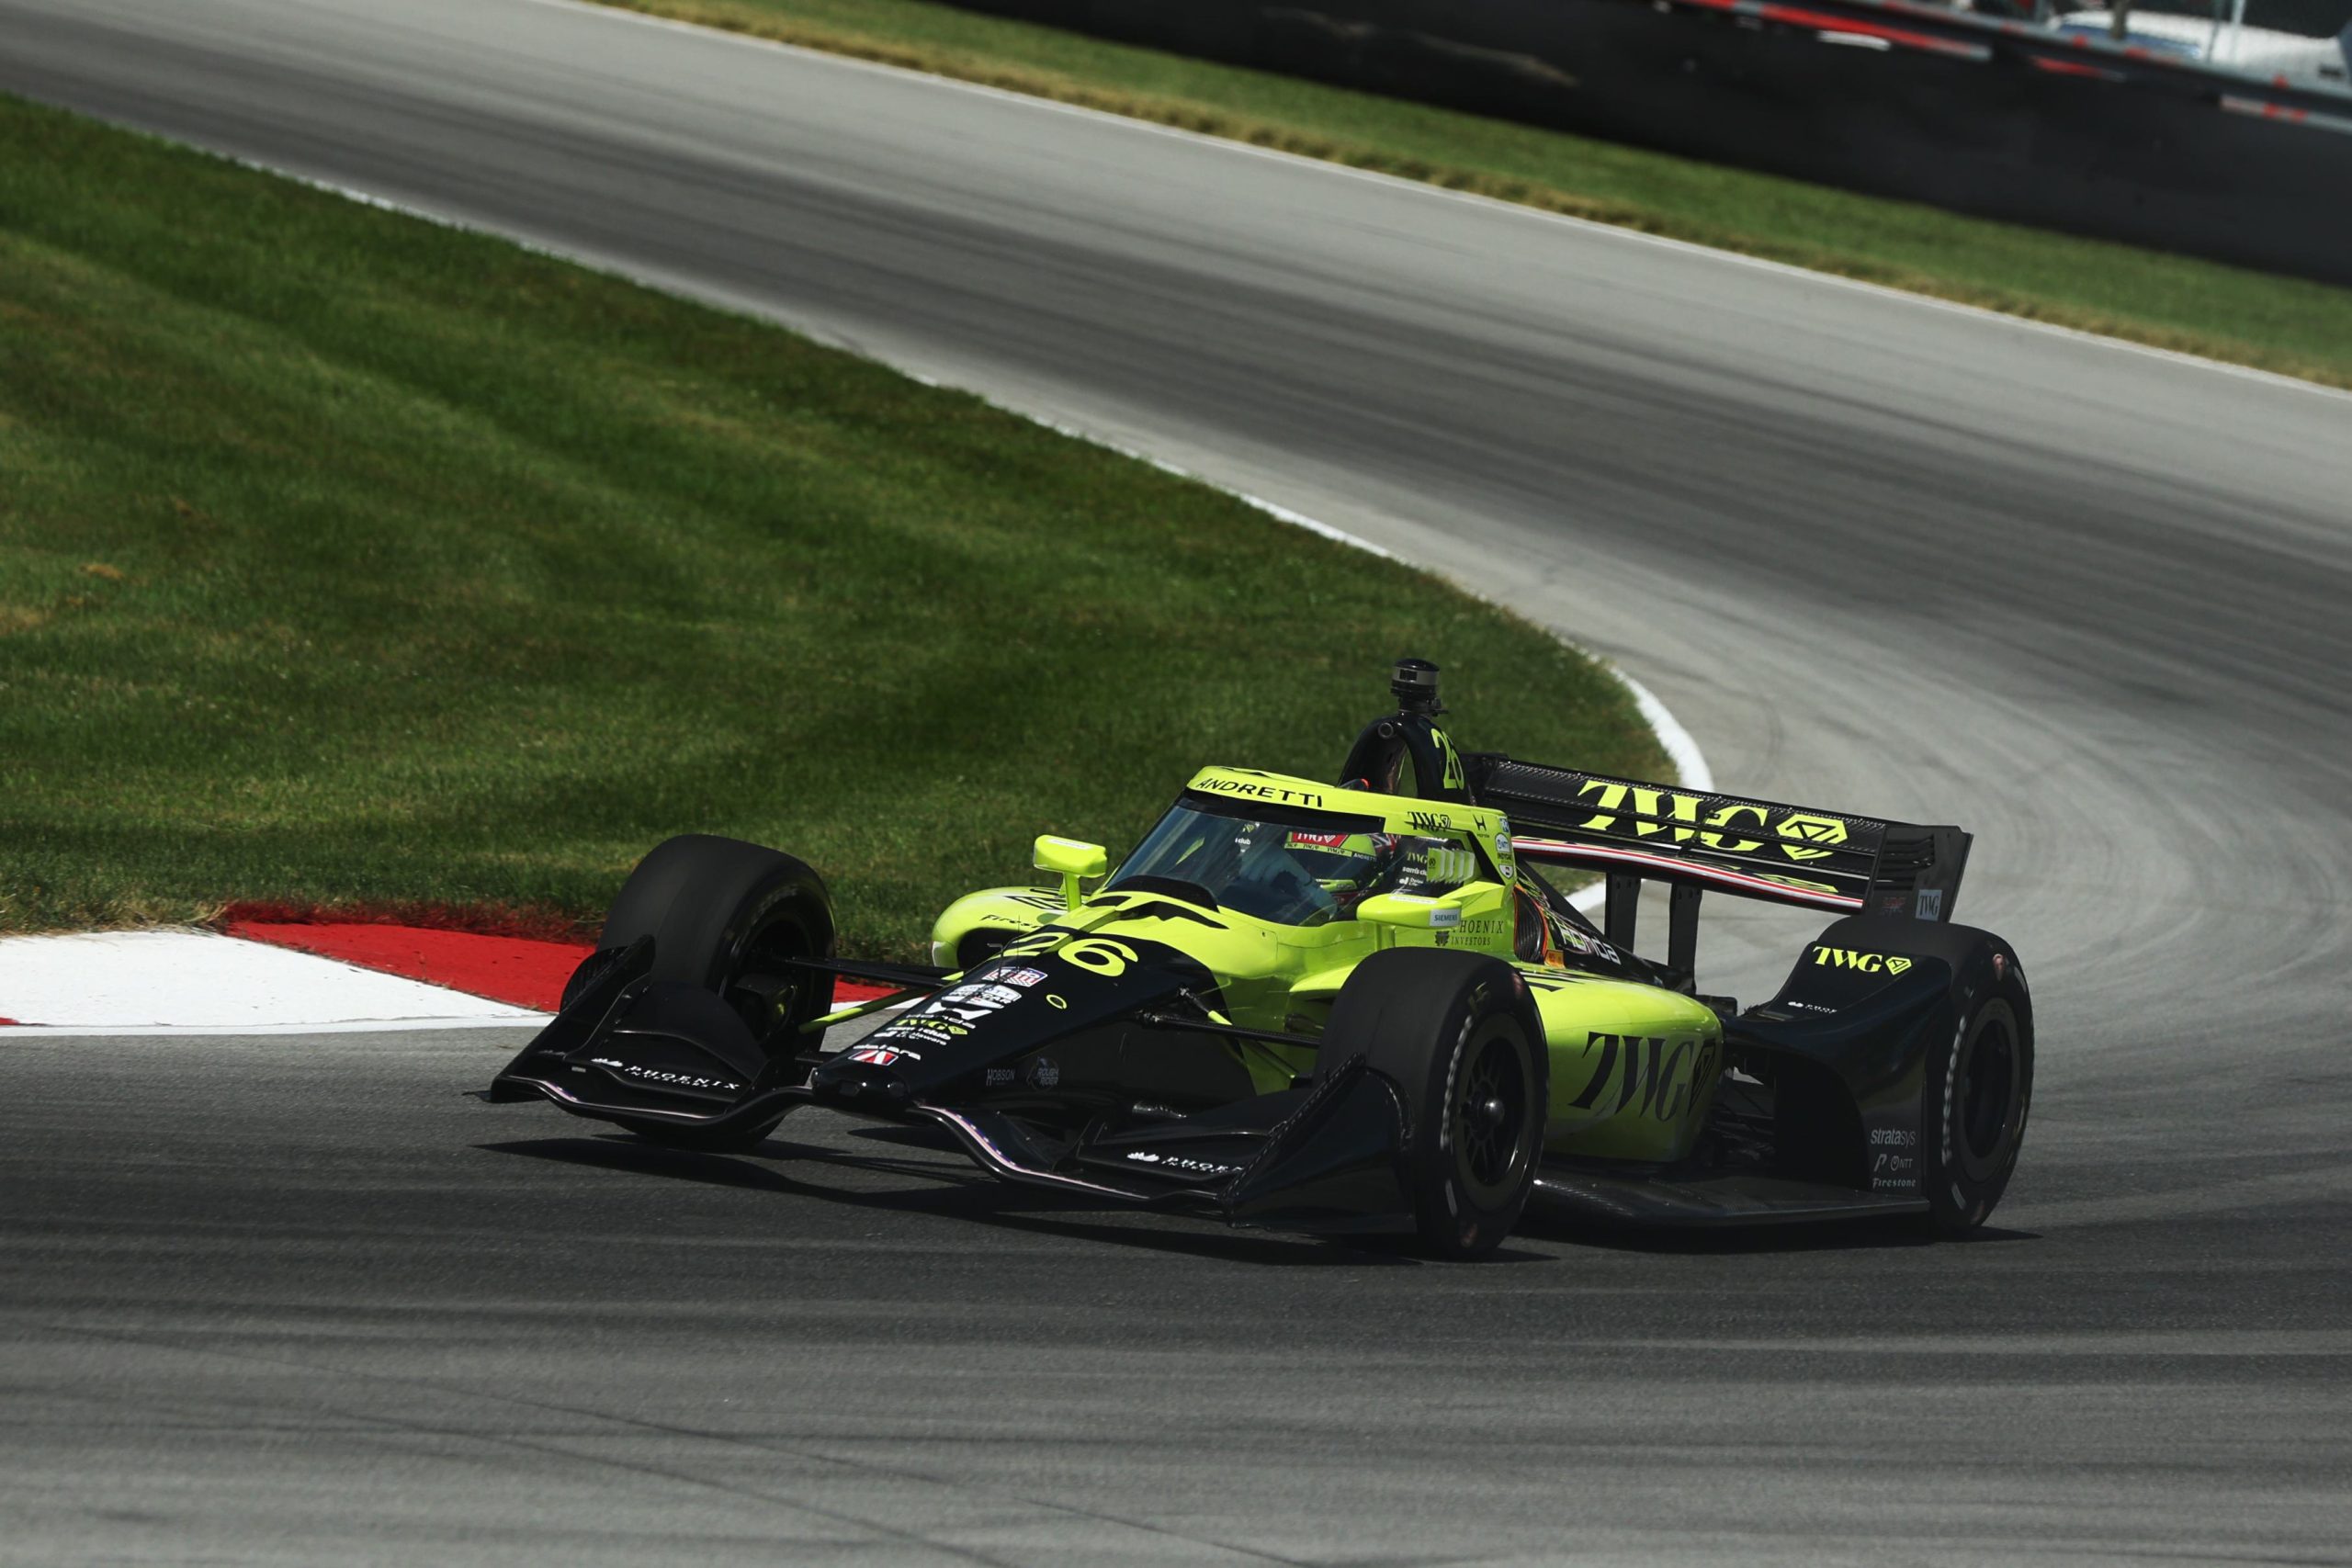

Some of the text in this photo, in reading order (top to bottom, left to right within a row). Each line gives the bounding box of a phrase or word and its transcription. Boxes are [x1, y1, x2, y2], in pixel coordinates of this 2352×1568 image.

[1430, 728, 1464, 790] 26
[1195, 778, 1322, 807] ANDRETTI
[1407, 811, 1442, 832] TWG
[1577, 780, 1768, 852] TWG
[1451, 936, 1491, 946] INVESTORS
[987, 932, 1138, 977] 26
[1813, 946, 1883, 973] TWG
[625, 1066, 740, 1089] PHOENIX
[1568, 1031, 1695, 1122] TWG
[1870, 1129, 1917, 1146] stratasys
[1899, 1158, 1913, 1169] NTT
[1872, 1178, 1917, 1190] Firestone
